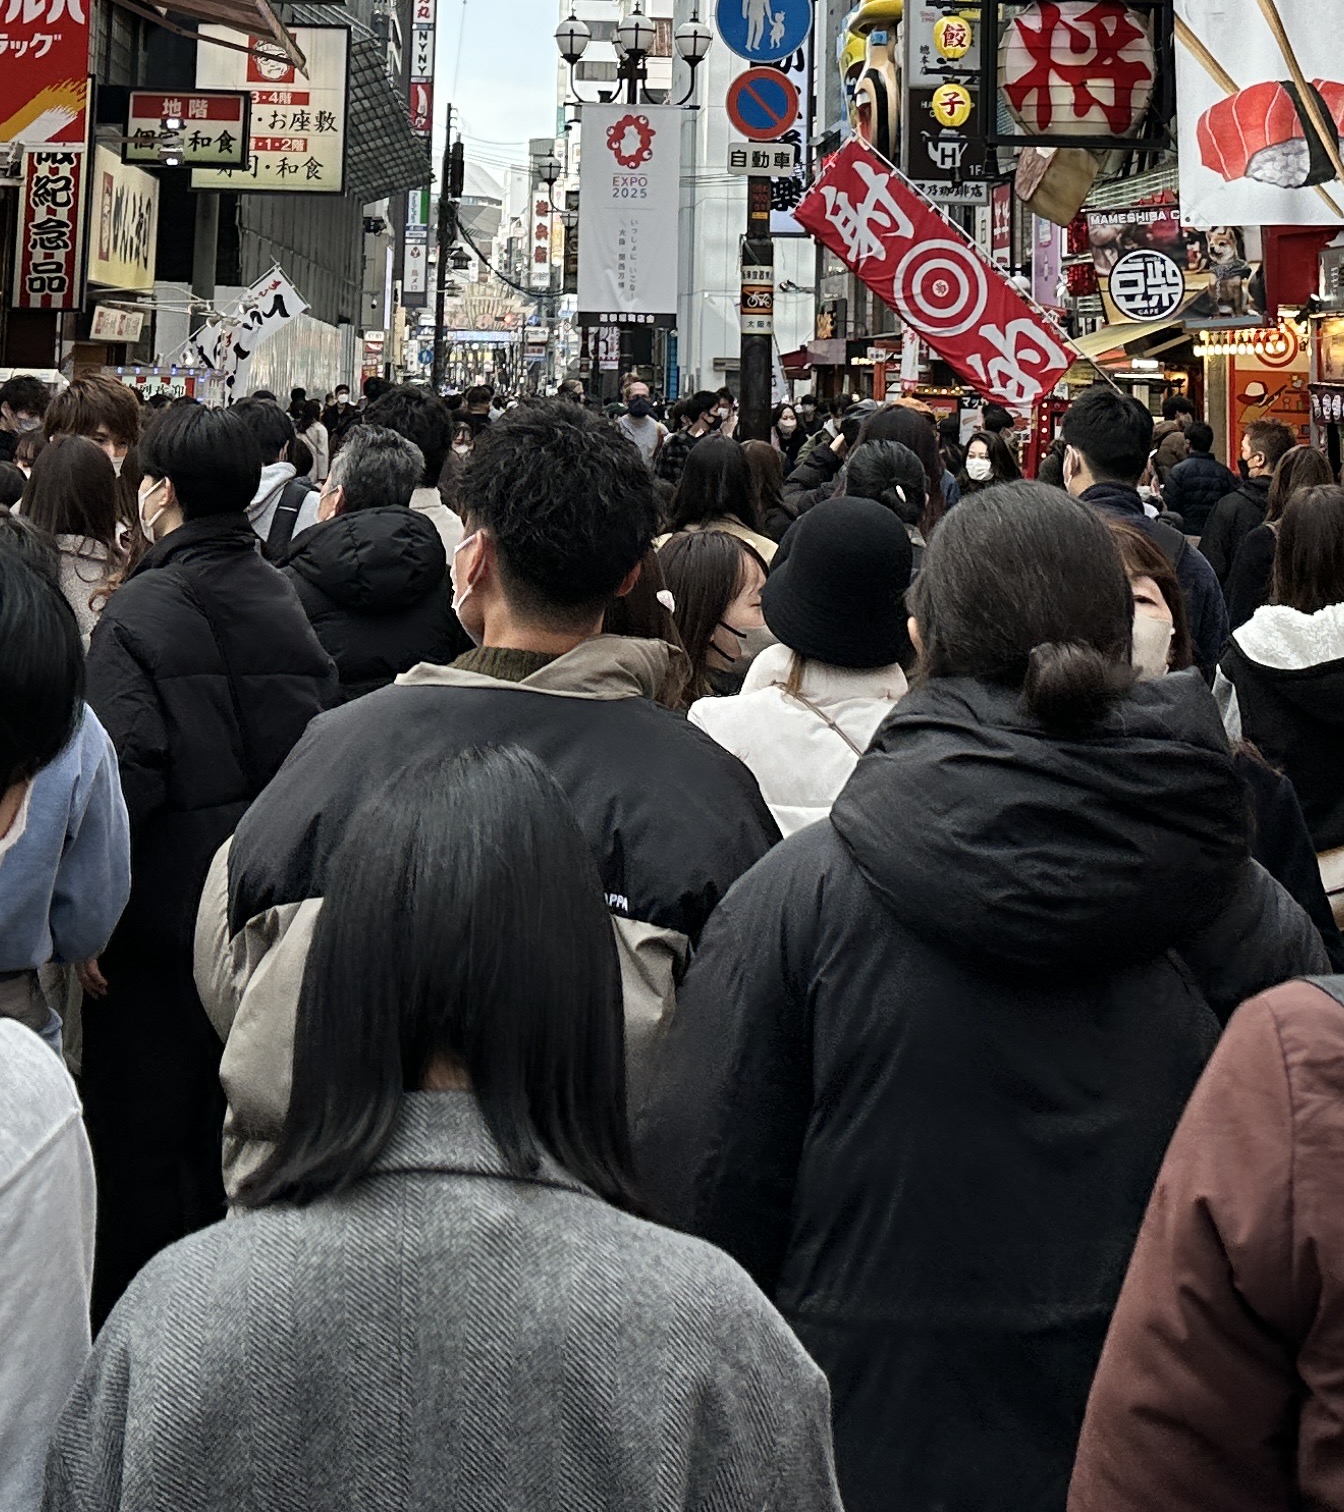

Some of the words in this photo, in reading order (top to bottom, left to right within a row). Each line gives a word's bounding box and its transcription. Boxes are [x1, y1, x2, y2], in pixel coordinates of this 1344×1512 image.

[417, 30, 428, 75] NYNY
[161, 98, 208, 118] 地階
[730, 149, 792, 170] 自動車
[612, 176, 649, 188] EXPO
[612, 188, 648, 199] 2025
[1090, 210, 1167, 226] MAMESHIBA
[823, 160, 1070, 405] 射的
